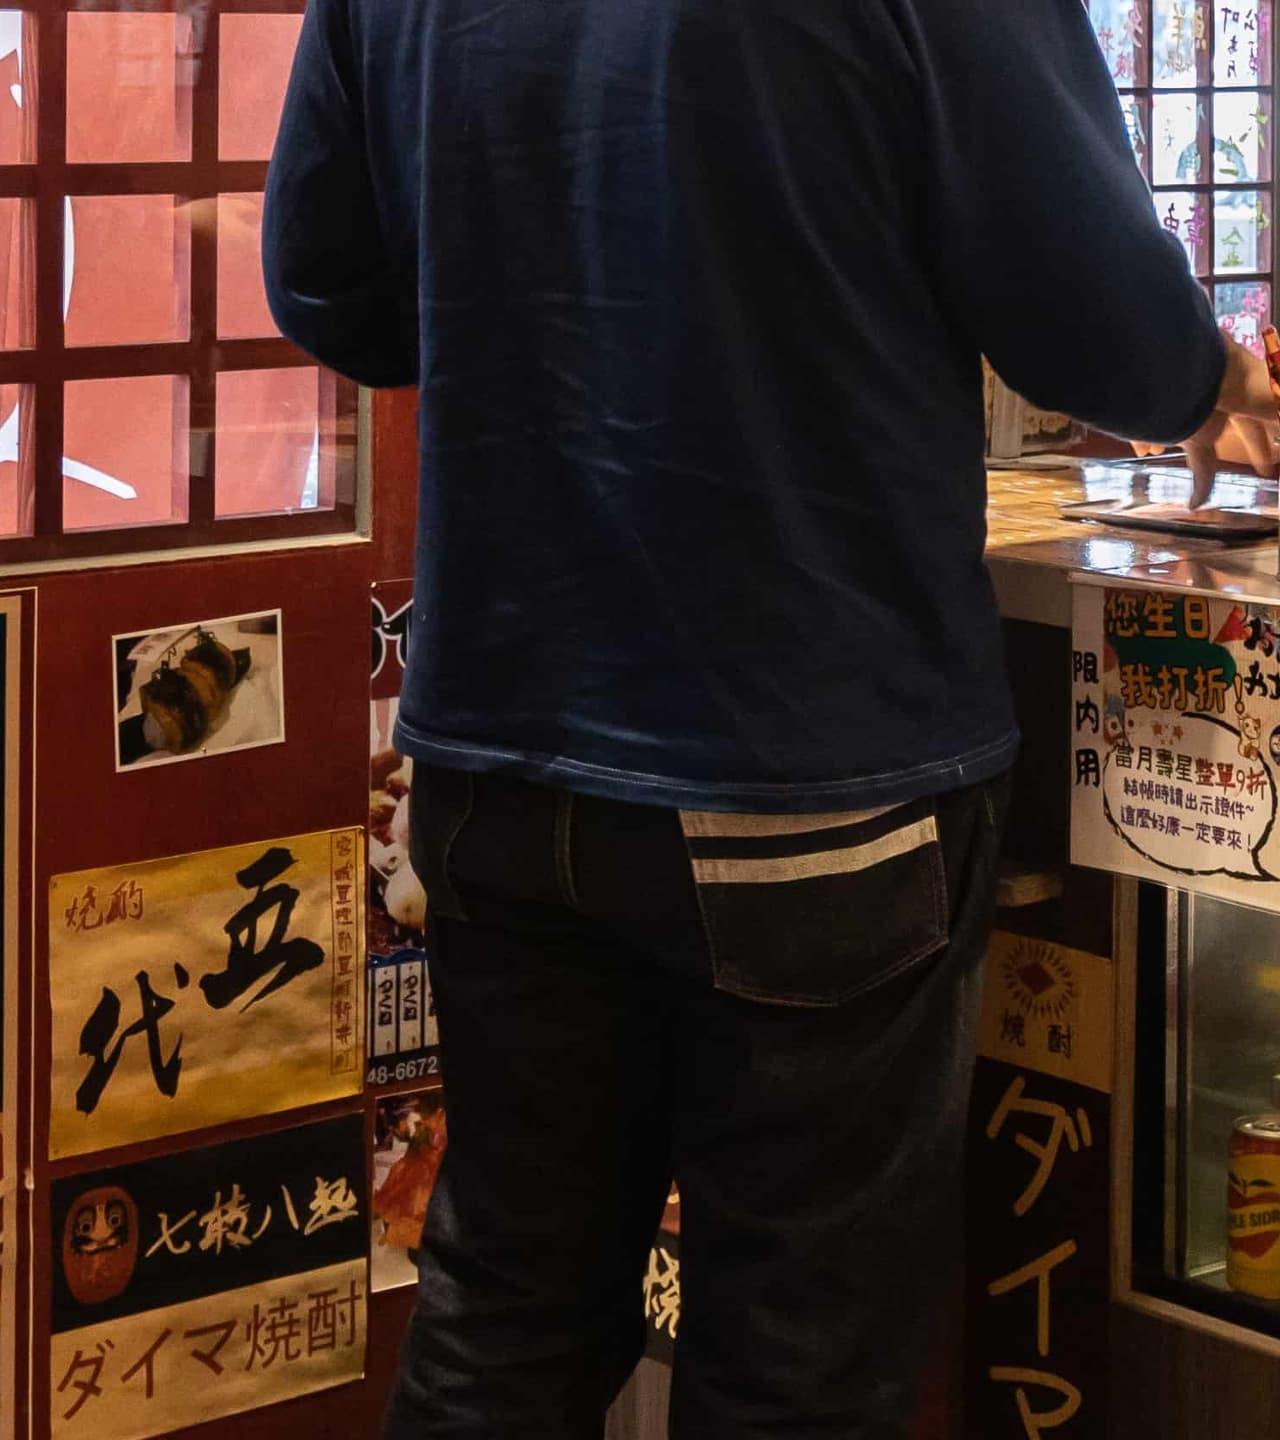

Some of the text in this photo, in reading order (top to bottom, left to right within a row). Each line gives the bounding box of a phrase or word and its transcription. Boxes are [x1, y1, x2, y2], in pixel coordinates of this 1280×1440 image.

[1105, 591, 1210, 639] 您生日
[57, 1279, 360, 1420] ダイマ焼酎
